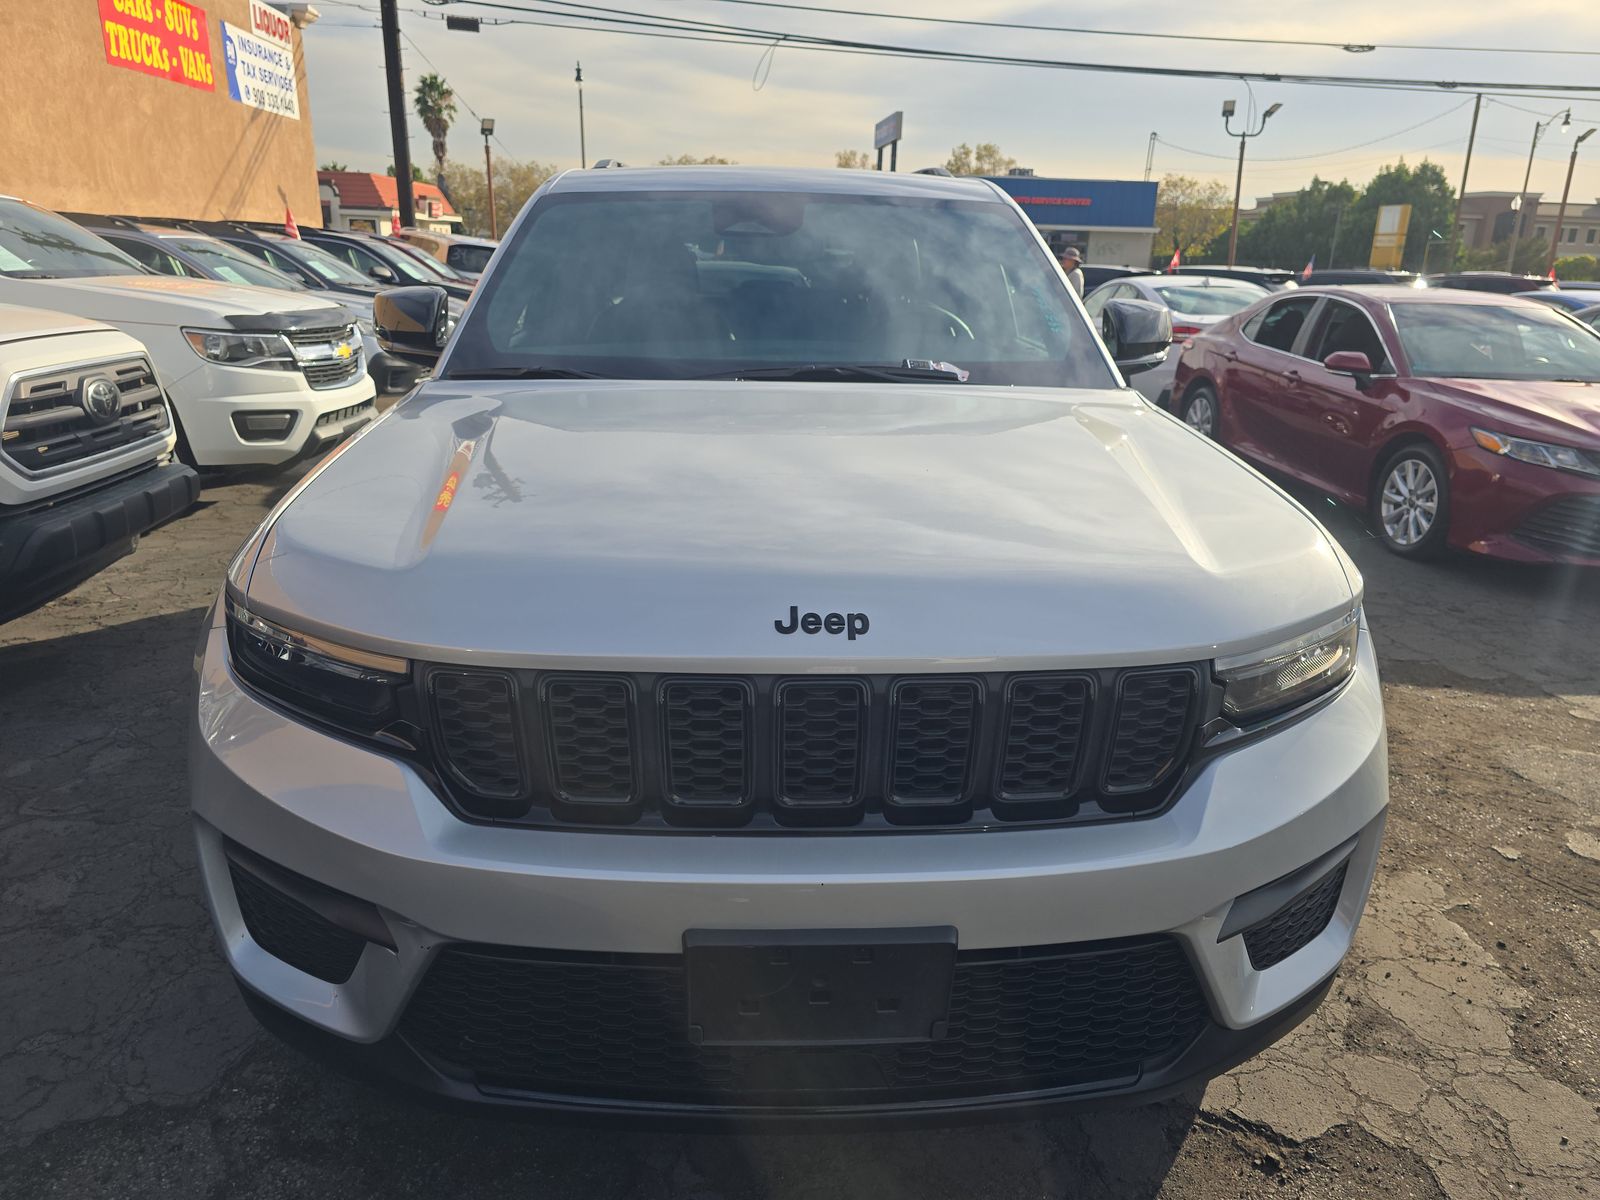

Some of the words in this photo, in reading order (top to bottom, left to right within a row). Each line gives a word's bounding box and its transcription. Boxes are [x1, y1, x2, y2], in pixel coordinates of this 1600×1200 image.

[252, 4, 290, 44] LIQUOR
[237, 34, 283, 68] INSURANCE
[241, 60, 257, 79] TAX
[259, 67, 293, 93] SERVICES
[1014, 196, 1031, 204] UTO
[1031, 196, 1062, 205] SERVICE
[1062, 198, 1092, 206] CENTER
[774, 606, 870, 640] Jeep
